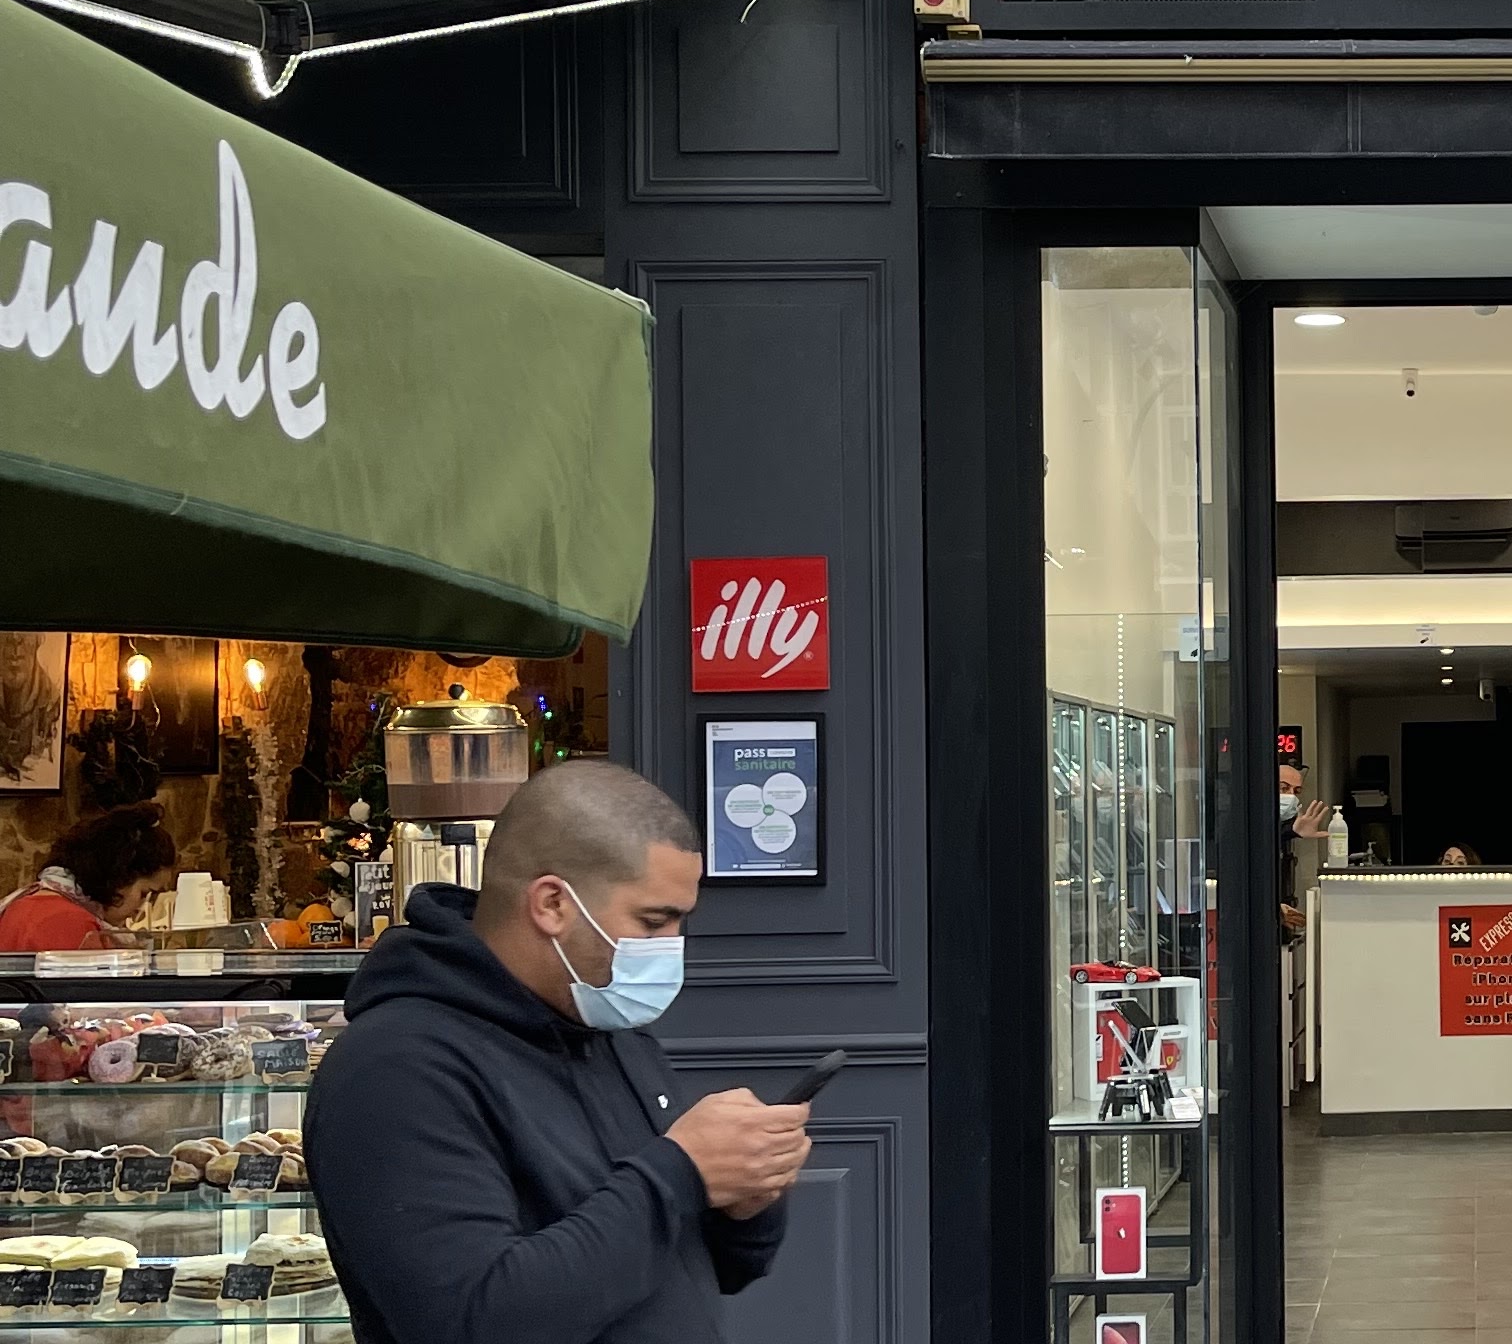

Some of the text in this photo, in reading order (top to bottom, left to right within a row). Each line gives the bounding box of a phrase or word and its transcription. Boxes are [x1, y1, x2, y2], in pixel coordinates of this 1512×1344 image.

[700, 576, 820, 679] illy
[734, 748, 766, 762] pass
[735, 759, 796, 771] sanitaire
[1464, 994, 1491, 1006] sur
[1464, 1014, 1502, 1026] sans
